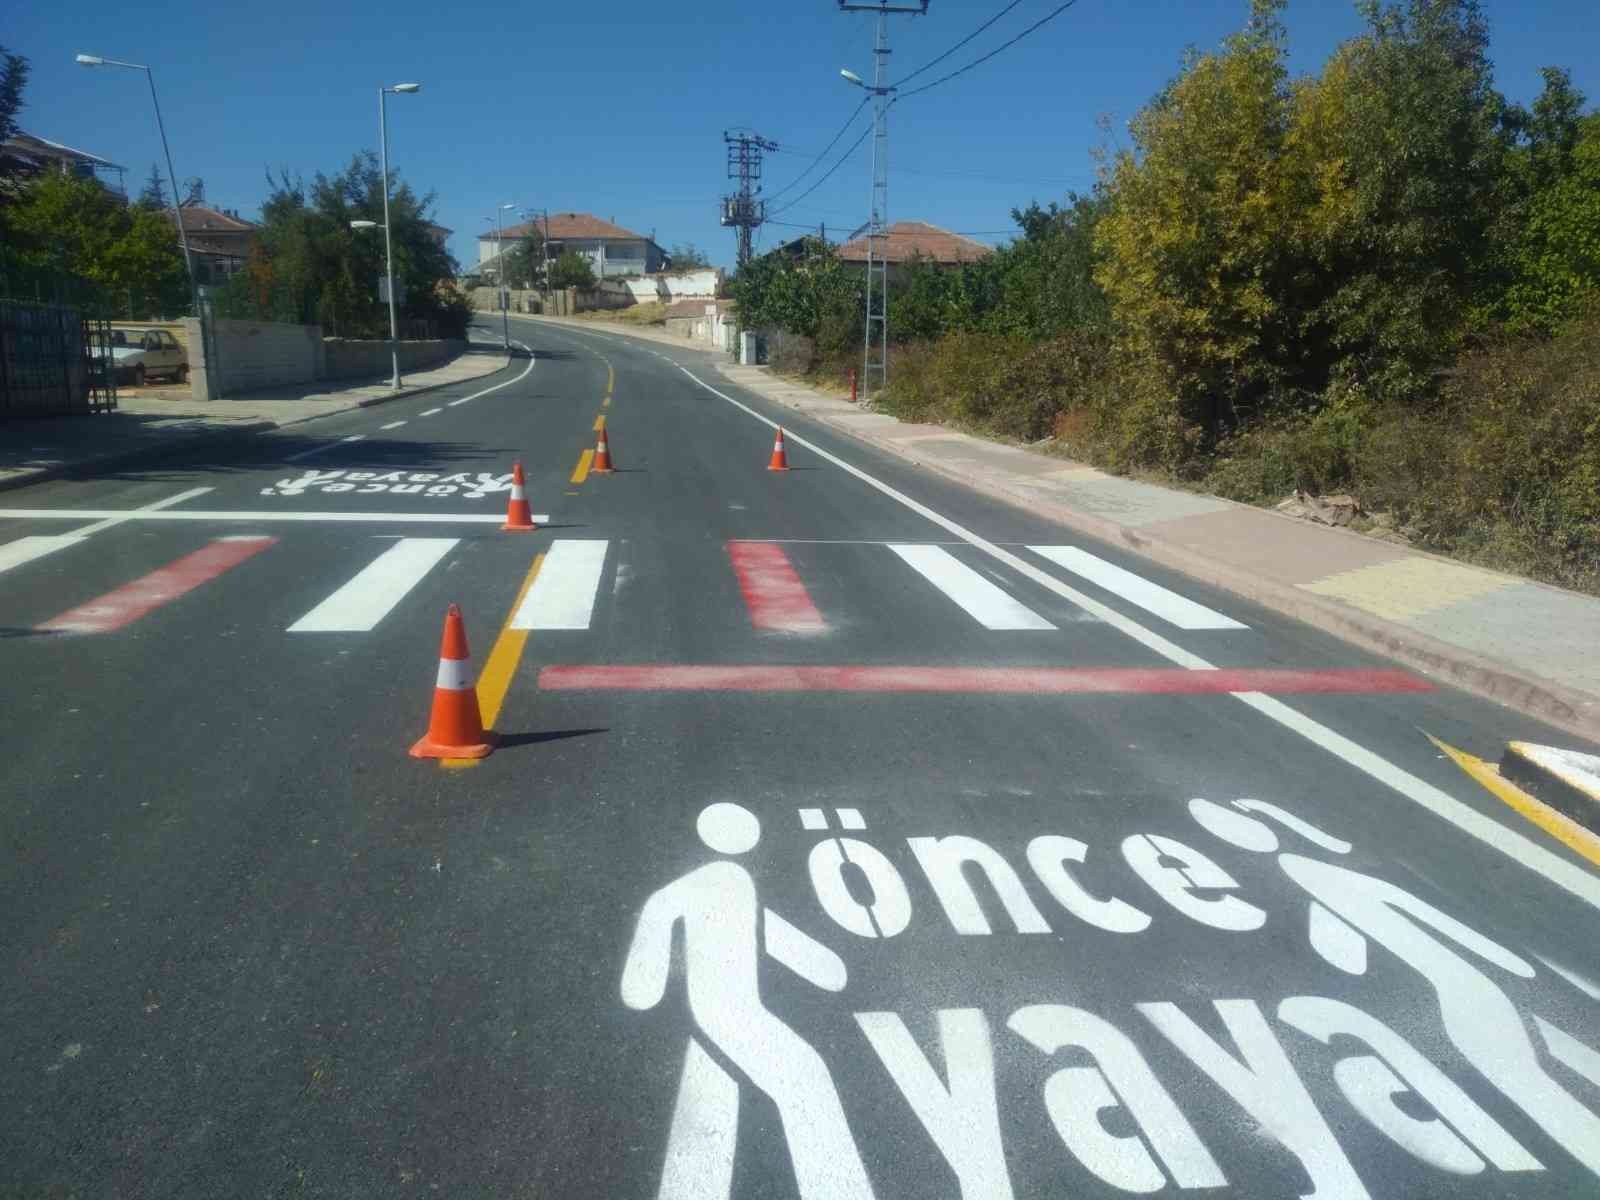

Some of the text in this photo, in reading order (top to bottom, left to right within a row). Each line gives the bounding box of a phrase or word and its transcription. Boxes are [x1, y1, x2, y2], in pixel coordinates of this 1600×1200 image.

[320, 483, 458, 497] önce
[344, 471, 472, 482] yaya
[799, 808, 1267, 938] önce
[854, 996, 1547, 1200] yaya
